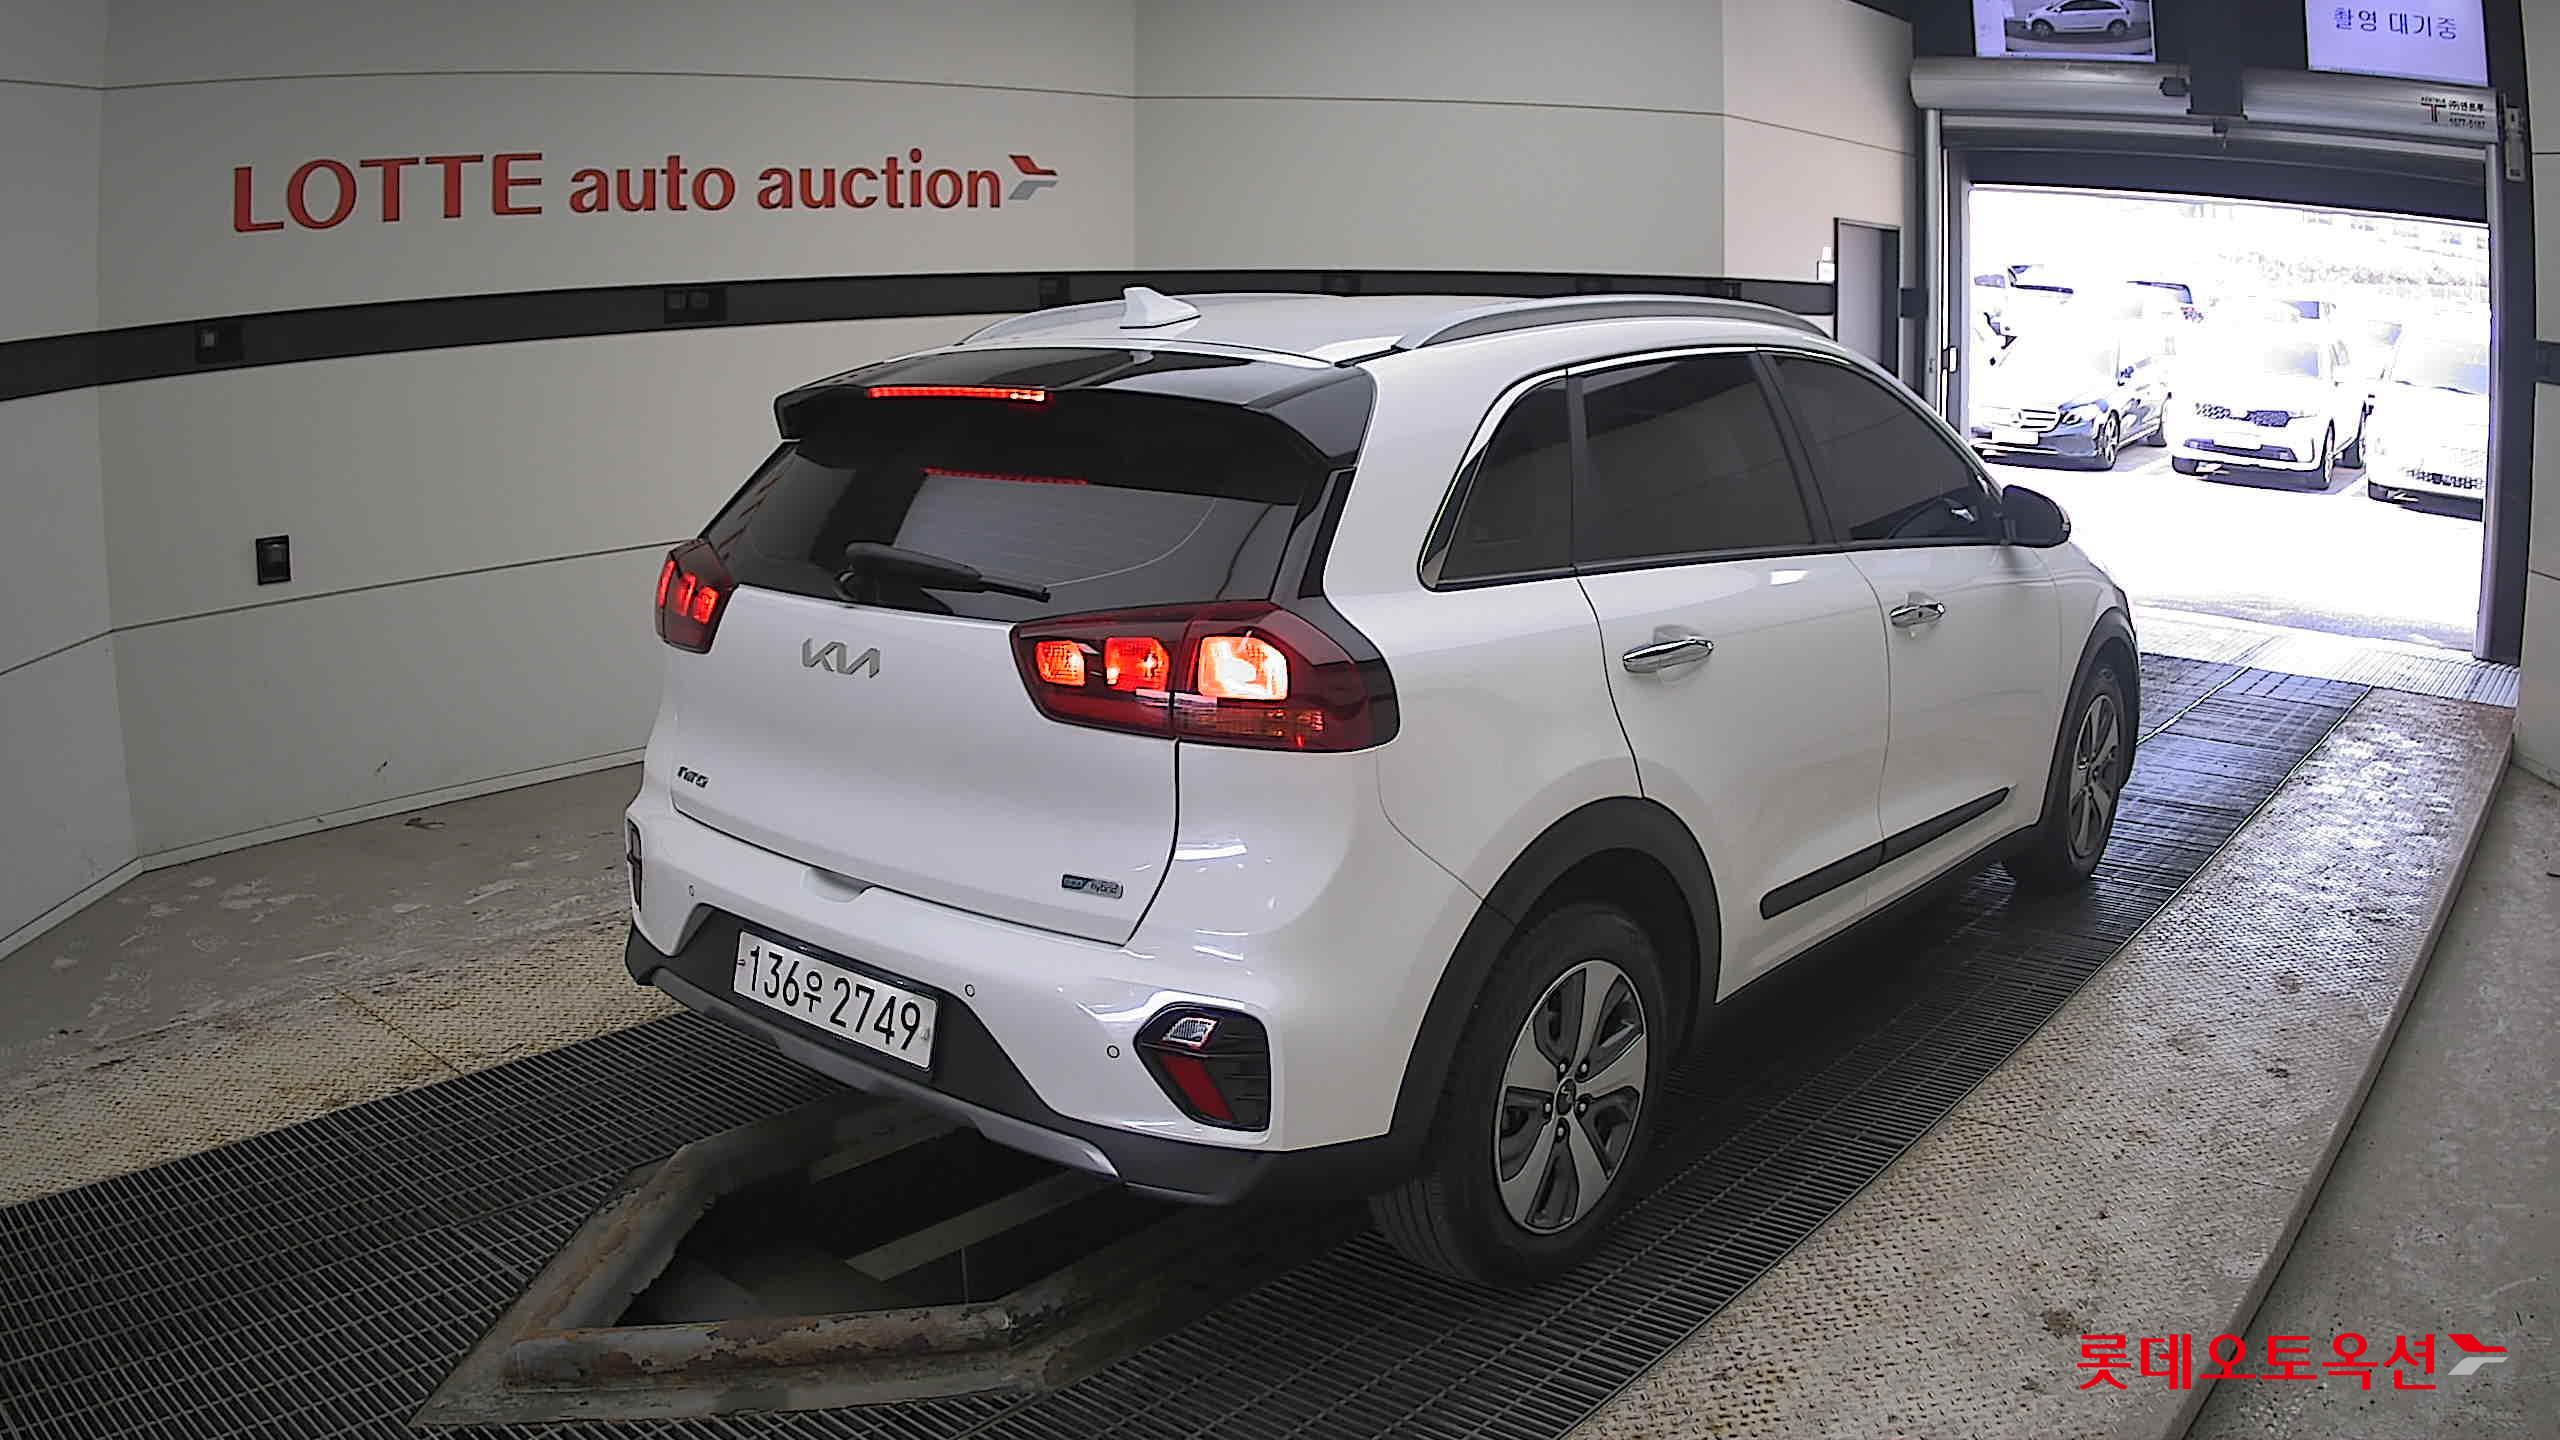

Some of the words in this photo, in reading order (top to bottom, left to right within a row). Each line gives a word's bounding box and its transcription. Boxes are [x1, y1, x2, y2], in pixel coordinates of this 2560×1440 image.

[2389, 13, 2457, 40] 대기중
[234, 152, 543, 233] LOTTE
[568, 155, 736, 214] auto
[757, 148, 1001, 210] auction
[751, 946, 823, 1013] 136우
[829, 977, 921, 1050] 2749
